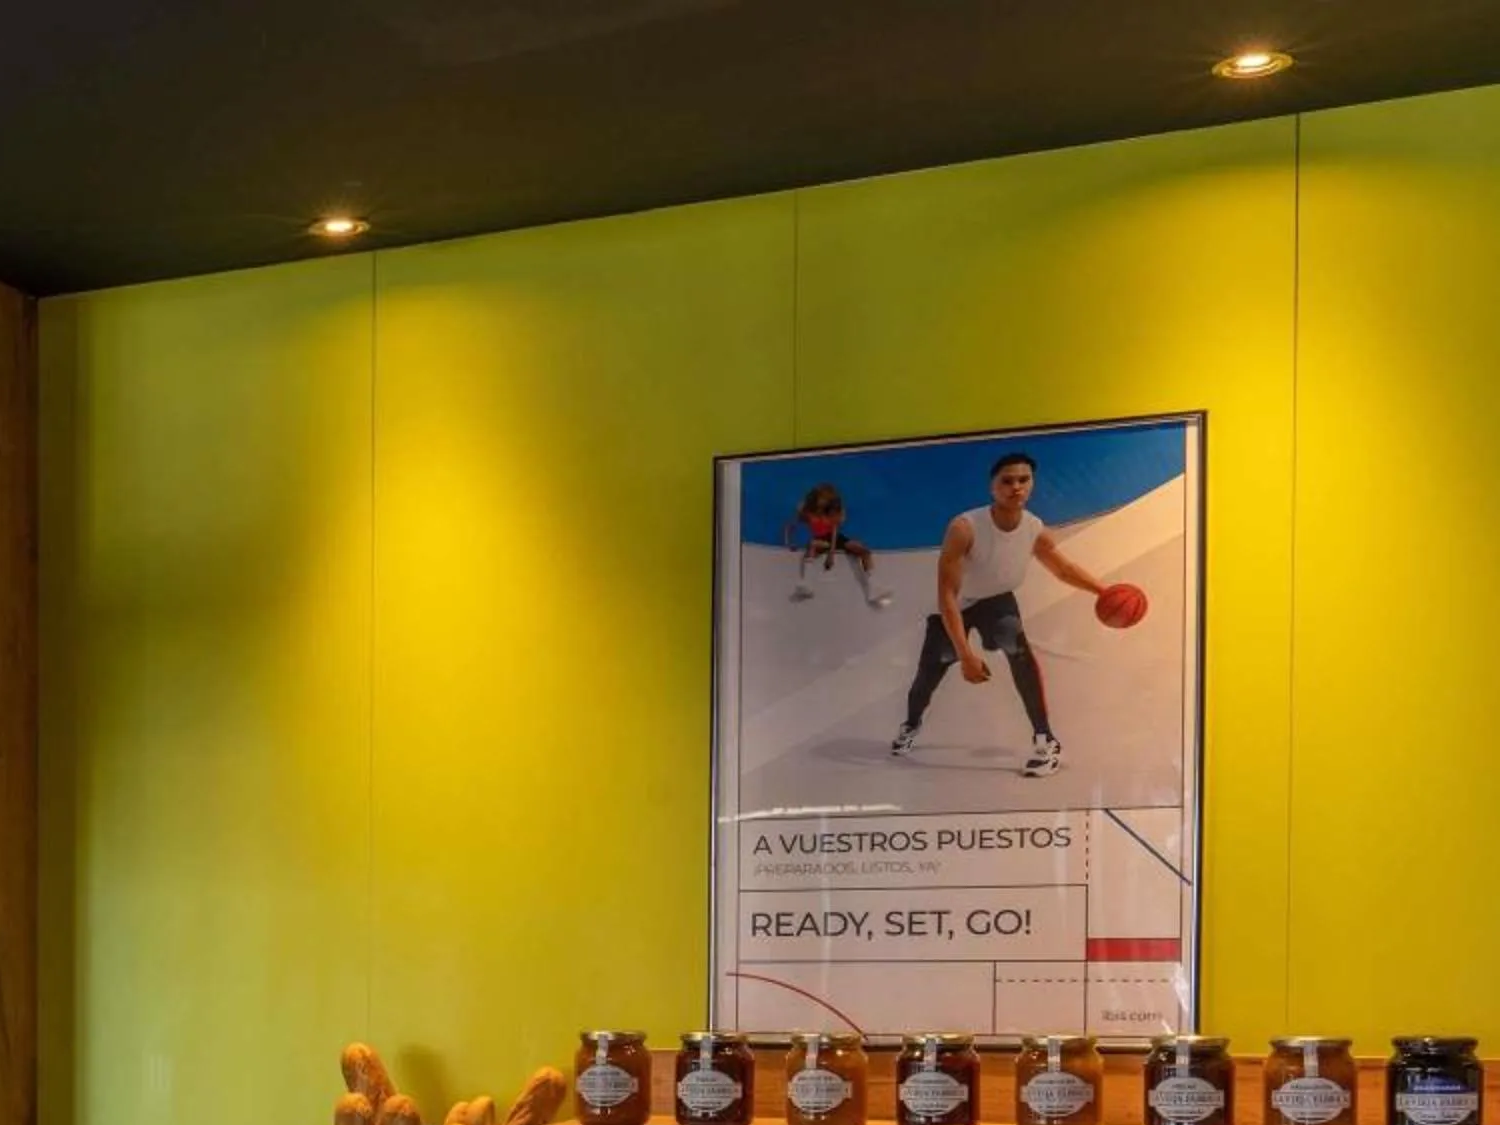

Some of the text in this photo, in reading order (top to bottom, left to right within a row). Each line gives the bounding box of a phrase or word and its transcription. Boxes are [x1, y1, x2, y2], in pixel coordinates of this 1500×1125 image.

[753, 827, 1071, 856] A VUESTROS PUESTOS
[751, 909, 1032, 940] READY, SET, GO!
